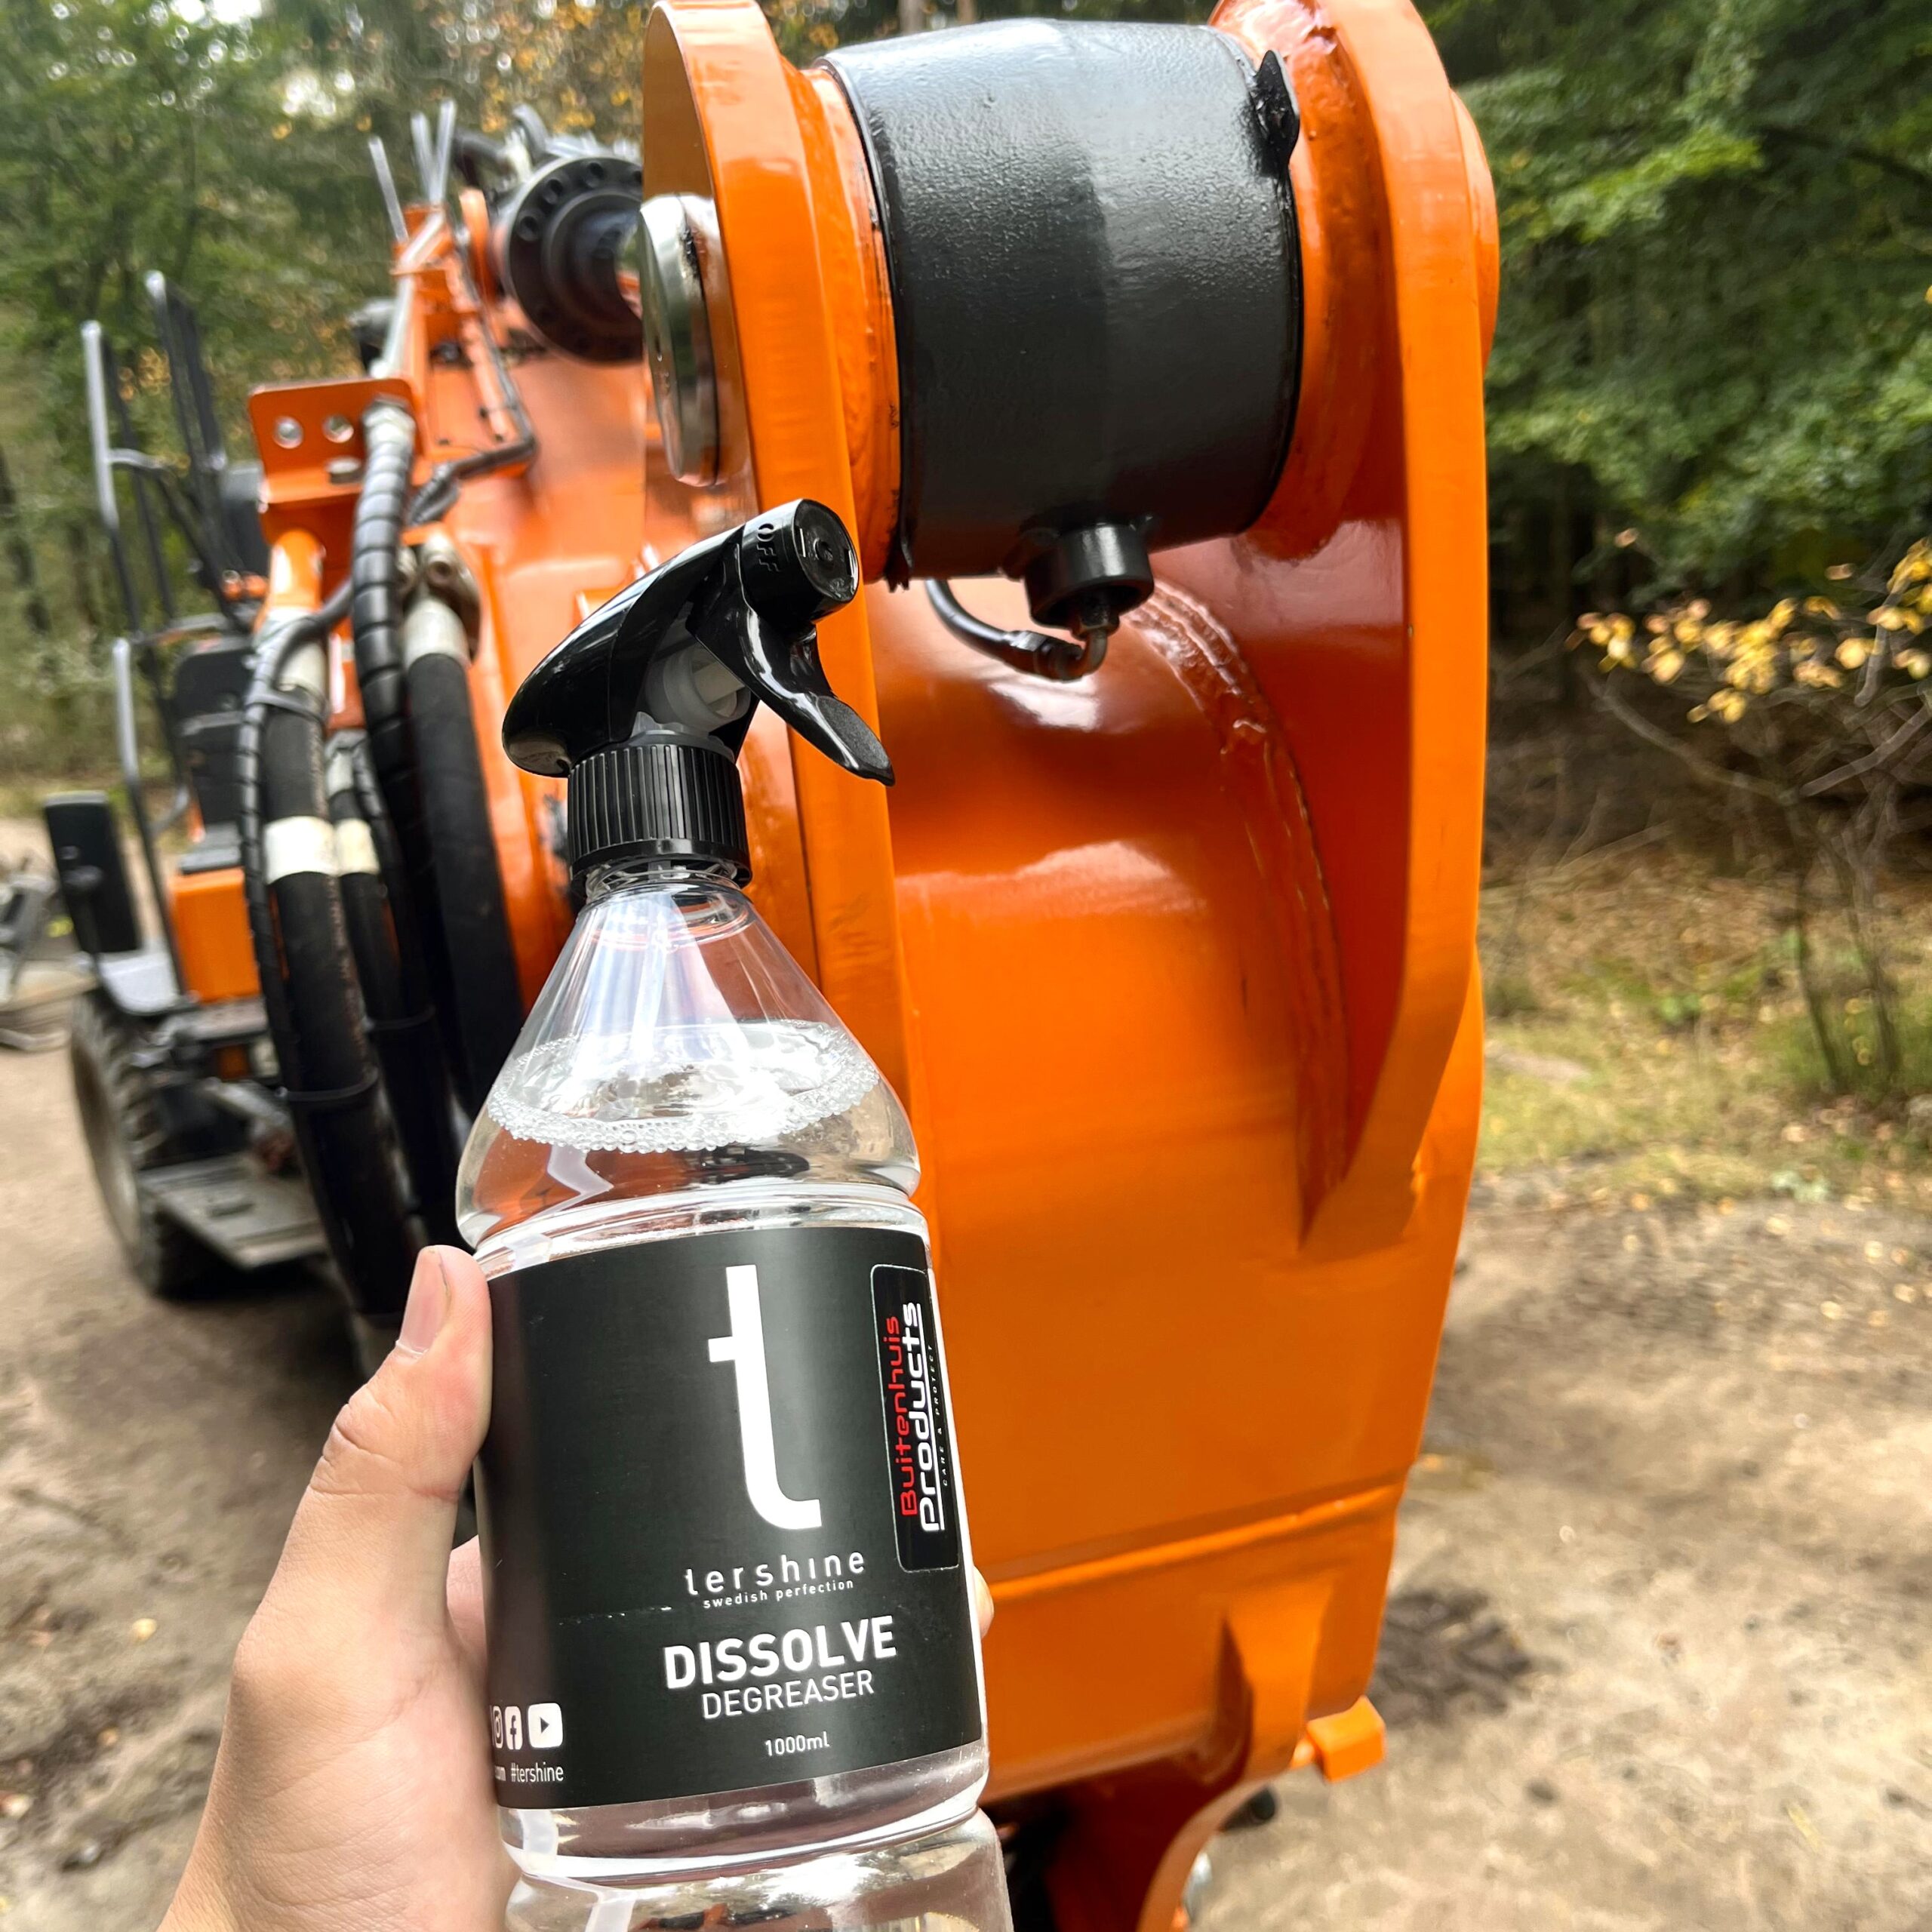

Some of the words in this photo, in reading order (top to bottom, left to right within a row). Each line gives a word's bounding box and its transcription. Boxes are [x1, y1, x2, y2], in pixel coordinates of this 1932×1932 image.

[756, 523, 780, 571] OFF
[928, 1345, 940, 1416] PROTECT
[883, 1315, 918, 1515] Buitenhuis
[940, 1446, 949, 1486] CARE
[685, 1552, 865, 1595] tershine
[703, 1590, 768, 1609] swedish
[776, 1580, 854, 1602] perfection
[664, 1615, 897, 1689] DISSOLVE
[702, 1669, 874, 1720] DEGREASER
[764, 1731, 830, 1757] 1000ml
[510, 1761, 565, 1783] #tershine
